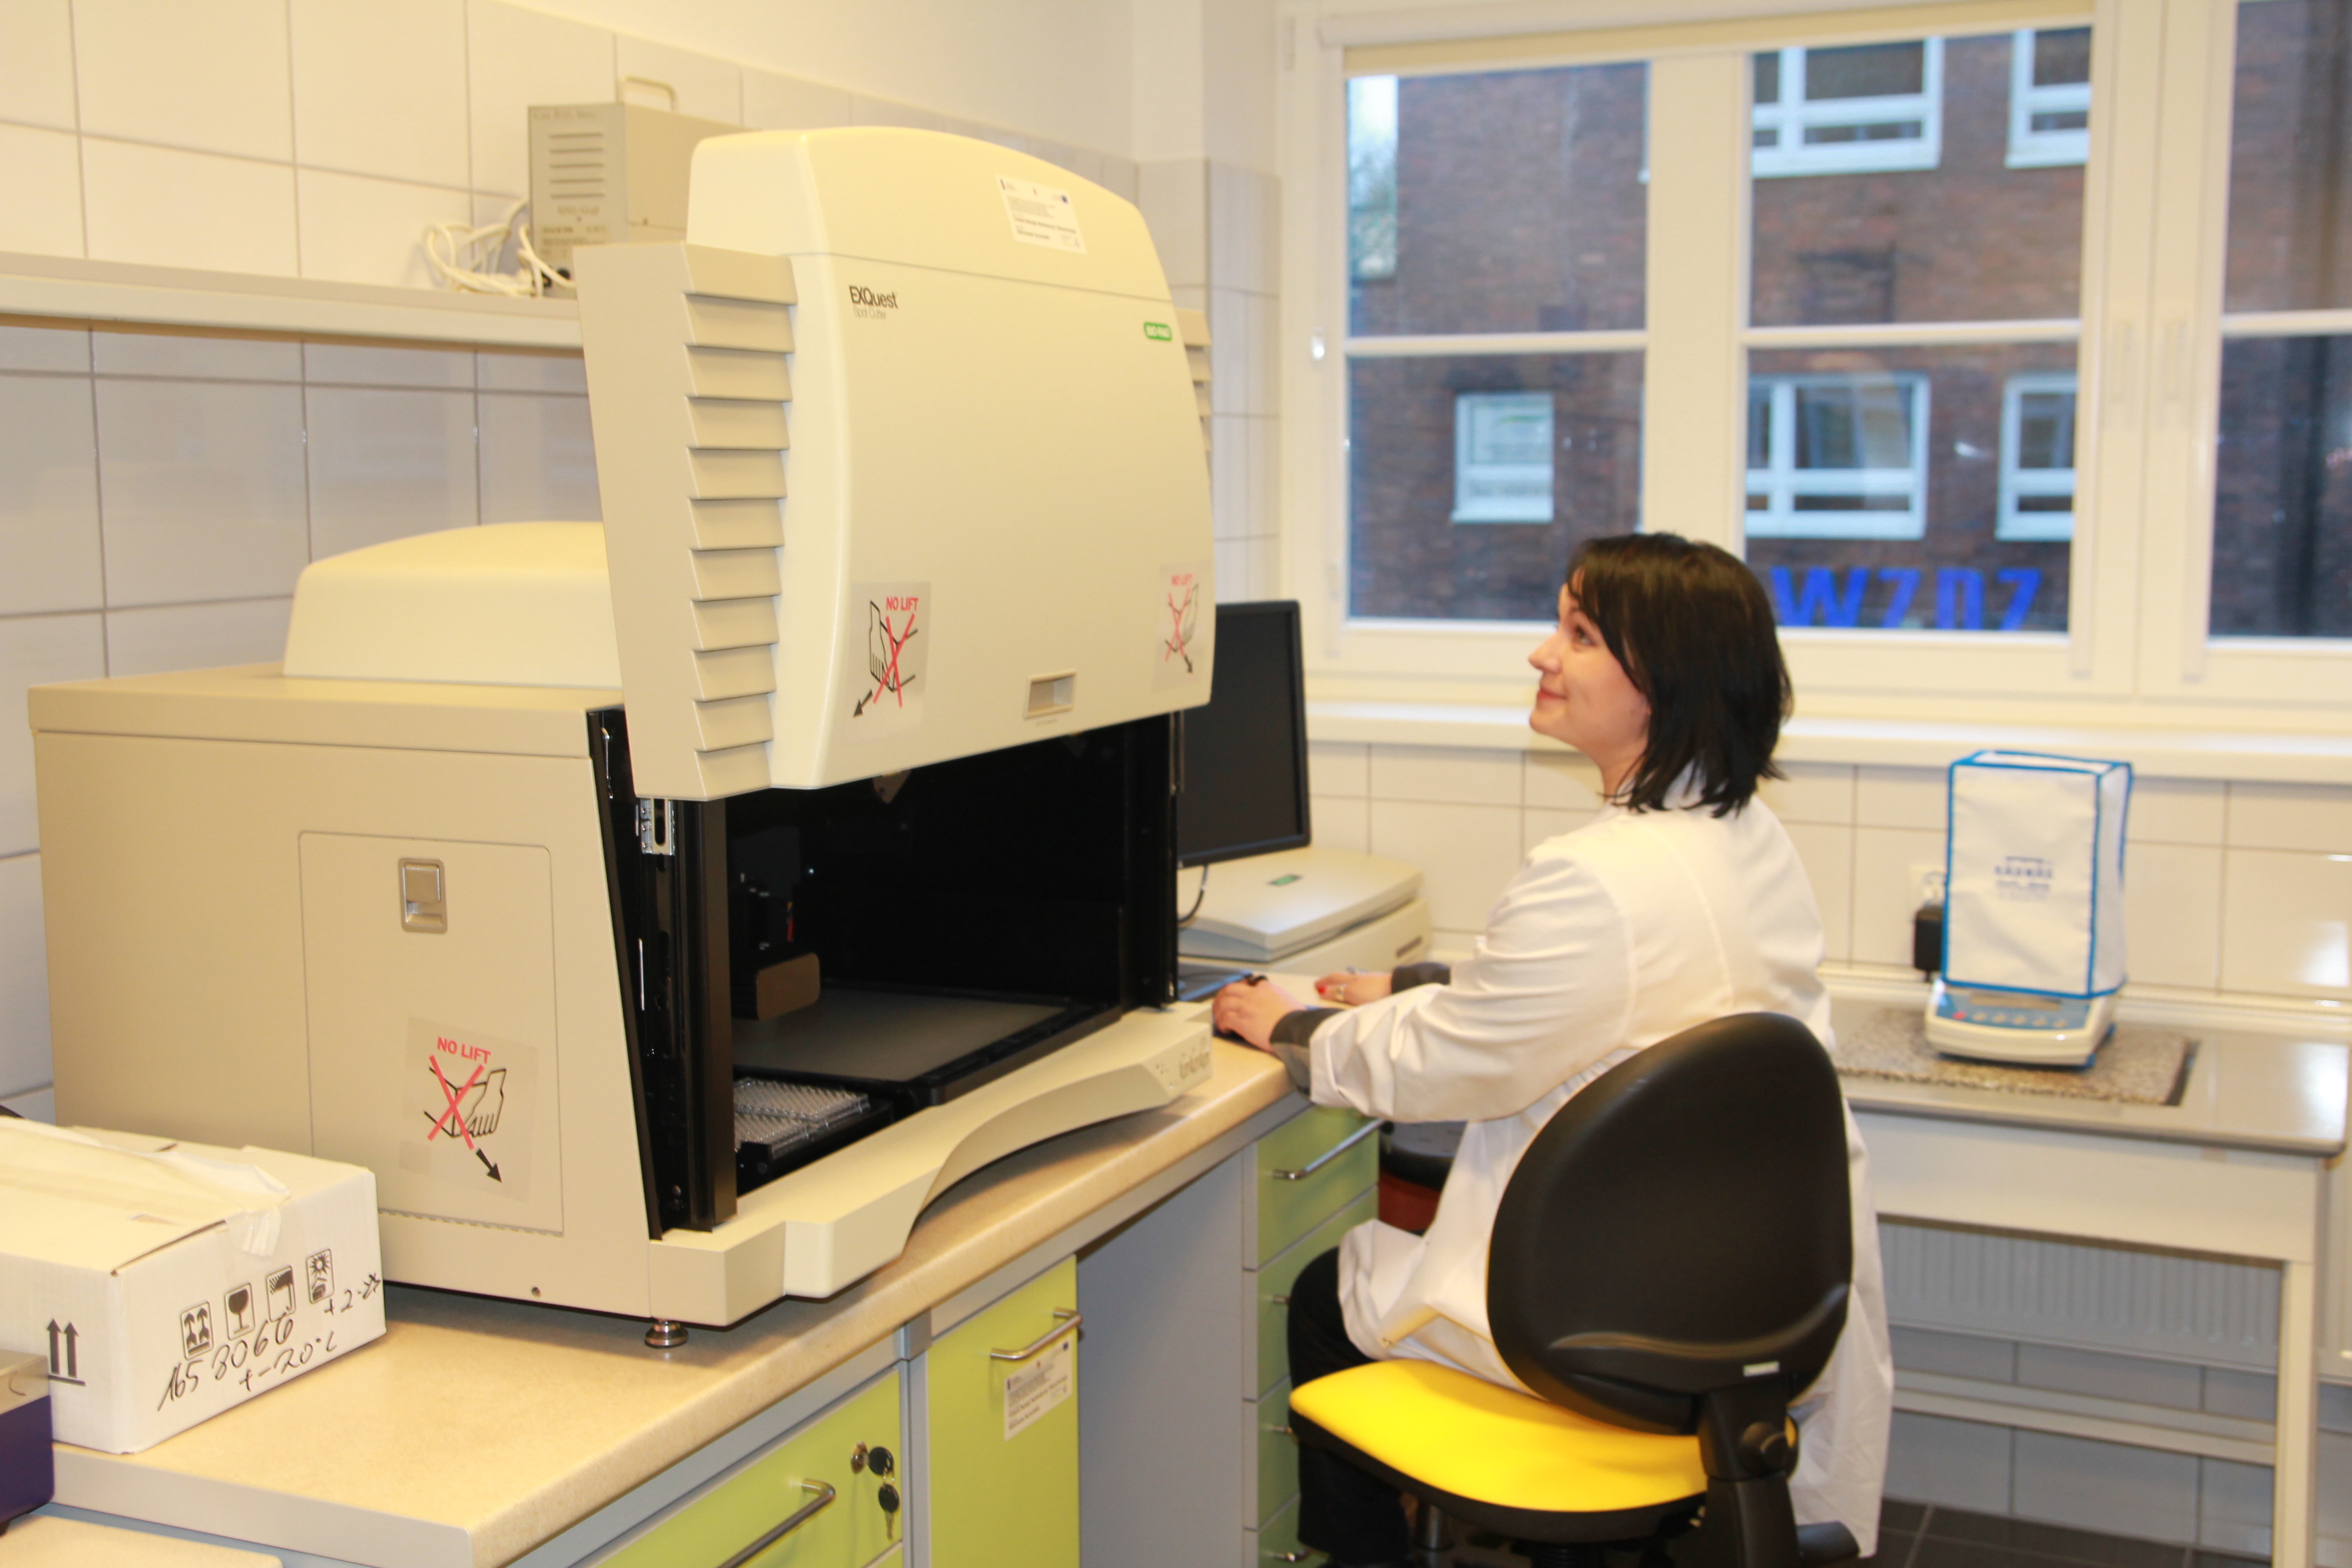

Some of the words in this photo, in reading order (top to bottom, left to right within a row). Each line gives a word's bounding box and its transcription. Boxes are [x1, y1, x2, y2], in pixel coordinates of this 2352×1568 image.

[848, 285, 898, 309] EXQuest
[886, 596, 899, 611] NO
[901, 596, 919, 612] LIFT
[438, 1036, 458, 1055] NO
[461, 1043, 491, 1064] LIFT
